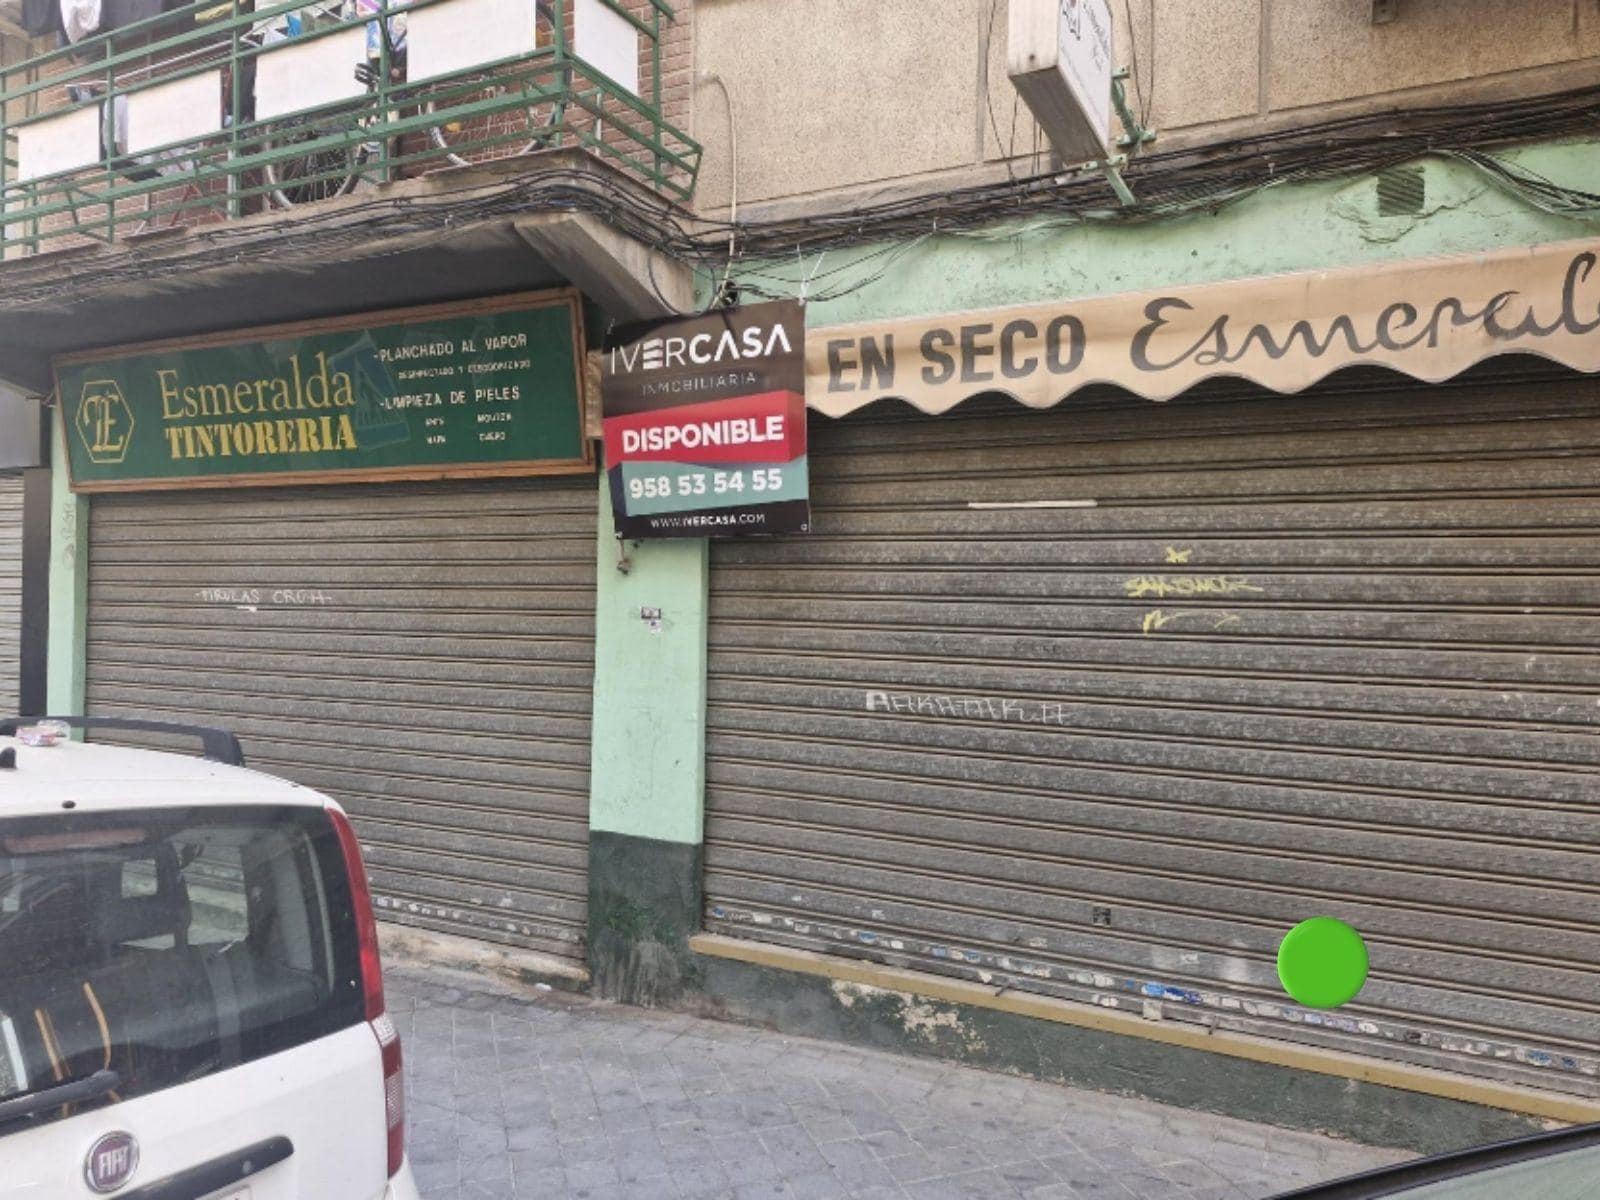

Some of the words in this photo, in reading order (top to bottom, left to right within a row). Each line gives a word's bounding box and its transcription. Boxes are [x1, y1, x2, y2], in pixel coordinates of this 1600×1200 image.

[827, 334, 895, 393] EN
[920, 315, 1086, 386] SECO
[1130, 250, 1600, 372] Esmeral
[462, 339, 477, 353] AL
[485, 333, 527, 351] VAPOR
[610, 324, 792, 375] IVERCASA
[156, 351, 357, 420] Esmeralda
[450, 391, 466, 404] DE
[475, 385, 520, 402] PIELES
[642, 371, 757, 397] INMOBILIARIA
[165, 414, 357, 460] TINTORERIA
[622, 415, 786, 454] DISPONIBLE
[629, 475, 672, 499] 958
[678, 473, 706, 496] 53
[714, 471, 744, 493] 54
[752, 468, 783, 491] 55
[650, 513, 766, 529] WWW.IVERCASA.COM
[98, 1146, 129, 1180] FIAT
